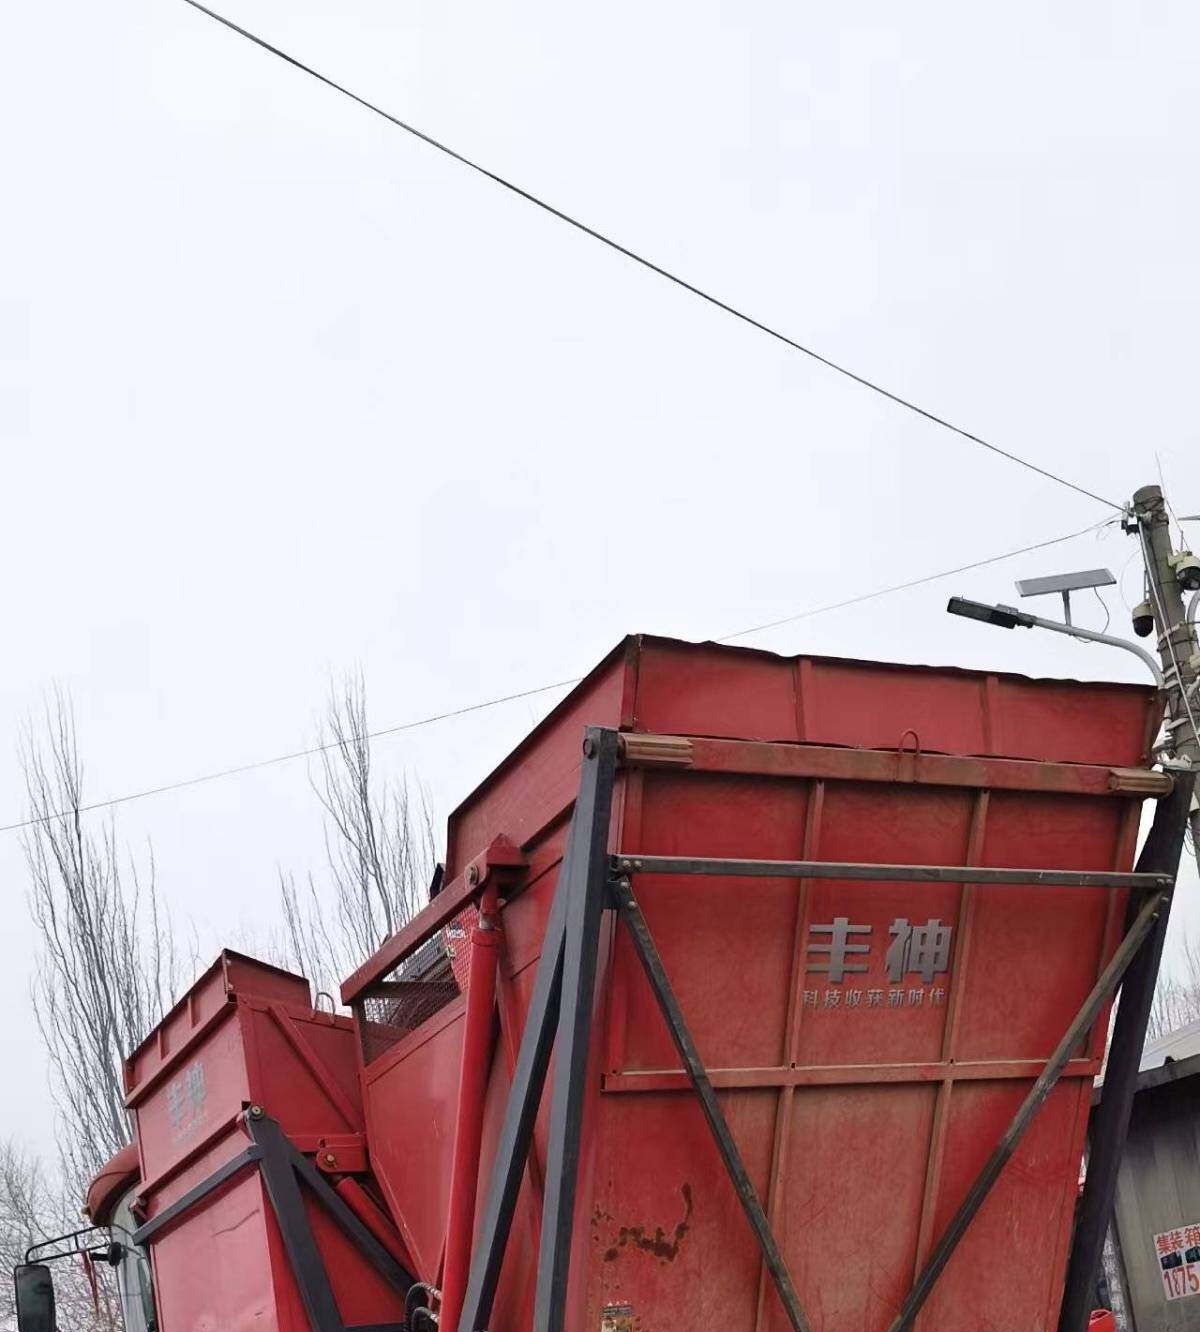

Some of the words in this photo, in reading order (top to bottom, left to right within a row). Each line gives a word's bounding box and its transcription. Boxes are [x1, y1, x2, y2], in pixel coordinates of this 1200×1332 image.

[806, 917, 953, 984] 丰神
[801, 987, 946, 1009] 科技收获新时代
[1157, 1225, 1200, 1255] 集装箱
